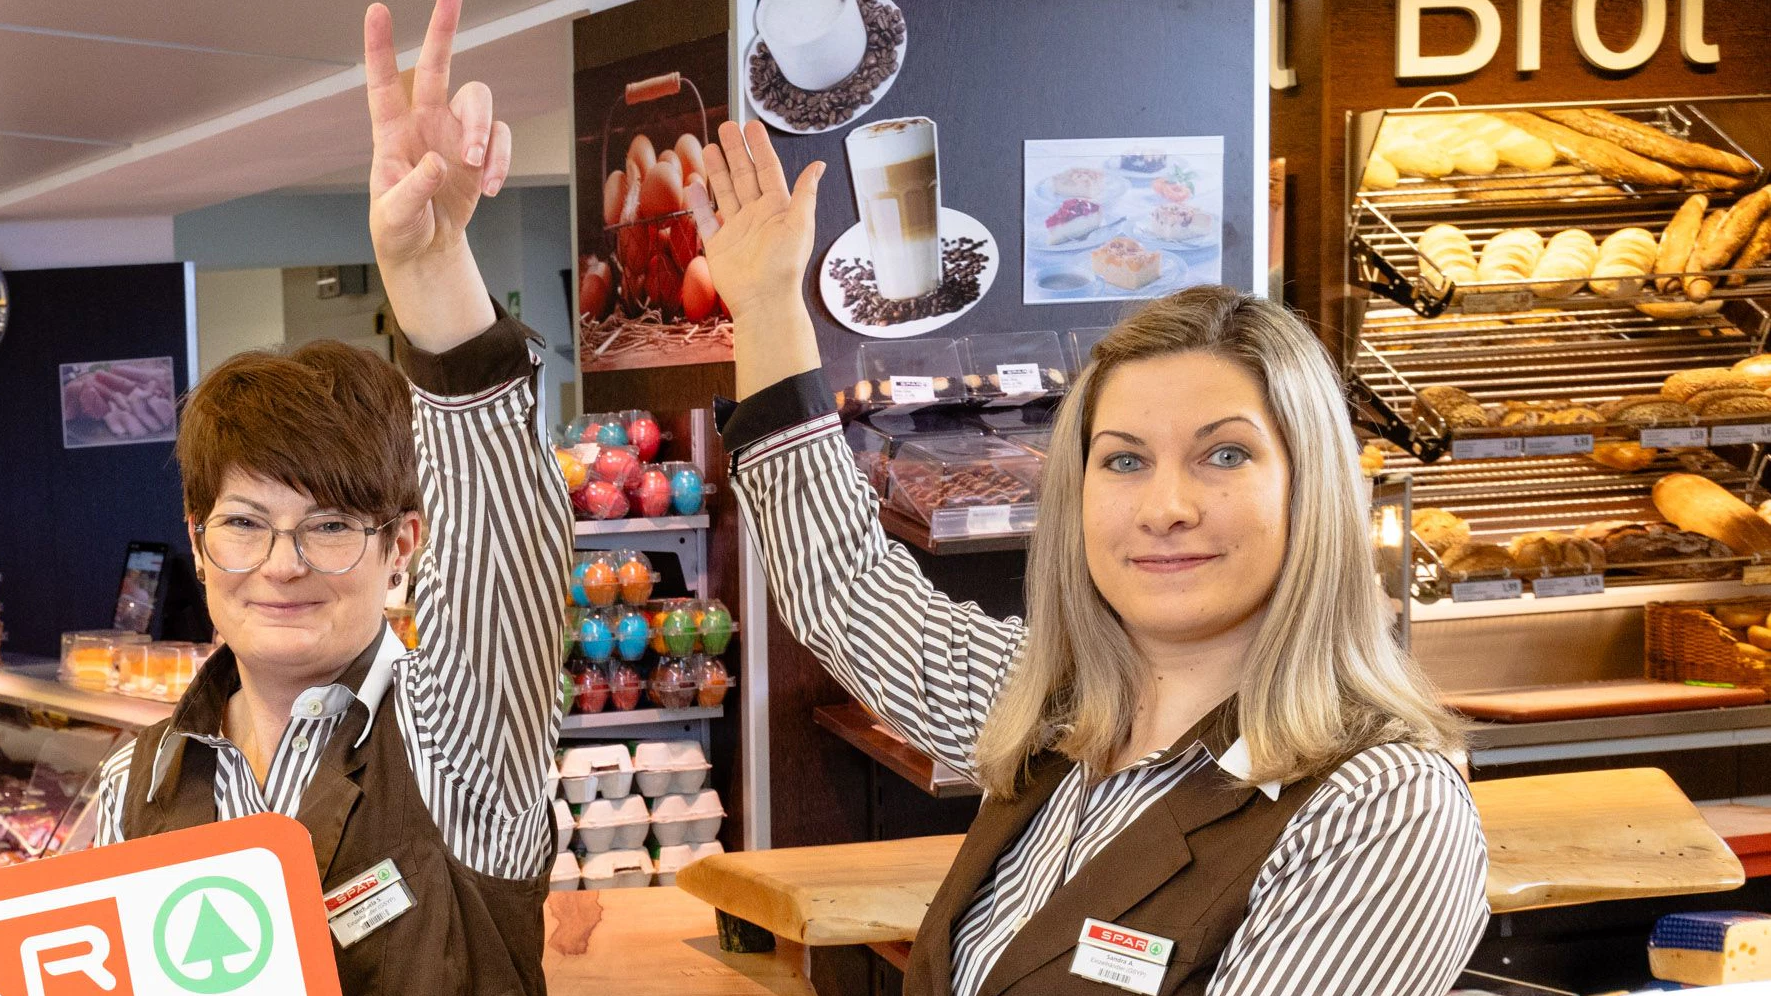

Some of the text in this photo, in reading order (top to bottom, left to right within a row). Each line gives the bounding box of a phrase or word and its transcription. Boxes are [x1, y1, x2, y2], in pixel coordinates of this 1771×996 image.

[336, 877, 378, 903] SPAR
[1100, 930, 1147, 950] SPAR
[1106, 954, 1128, 966] Sandra
